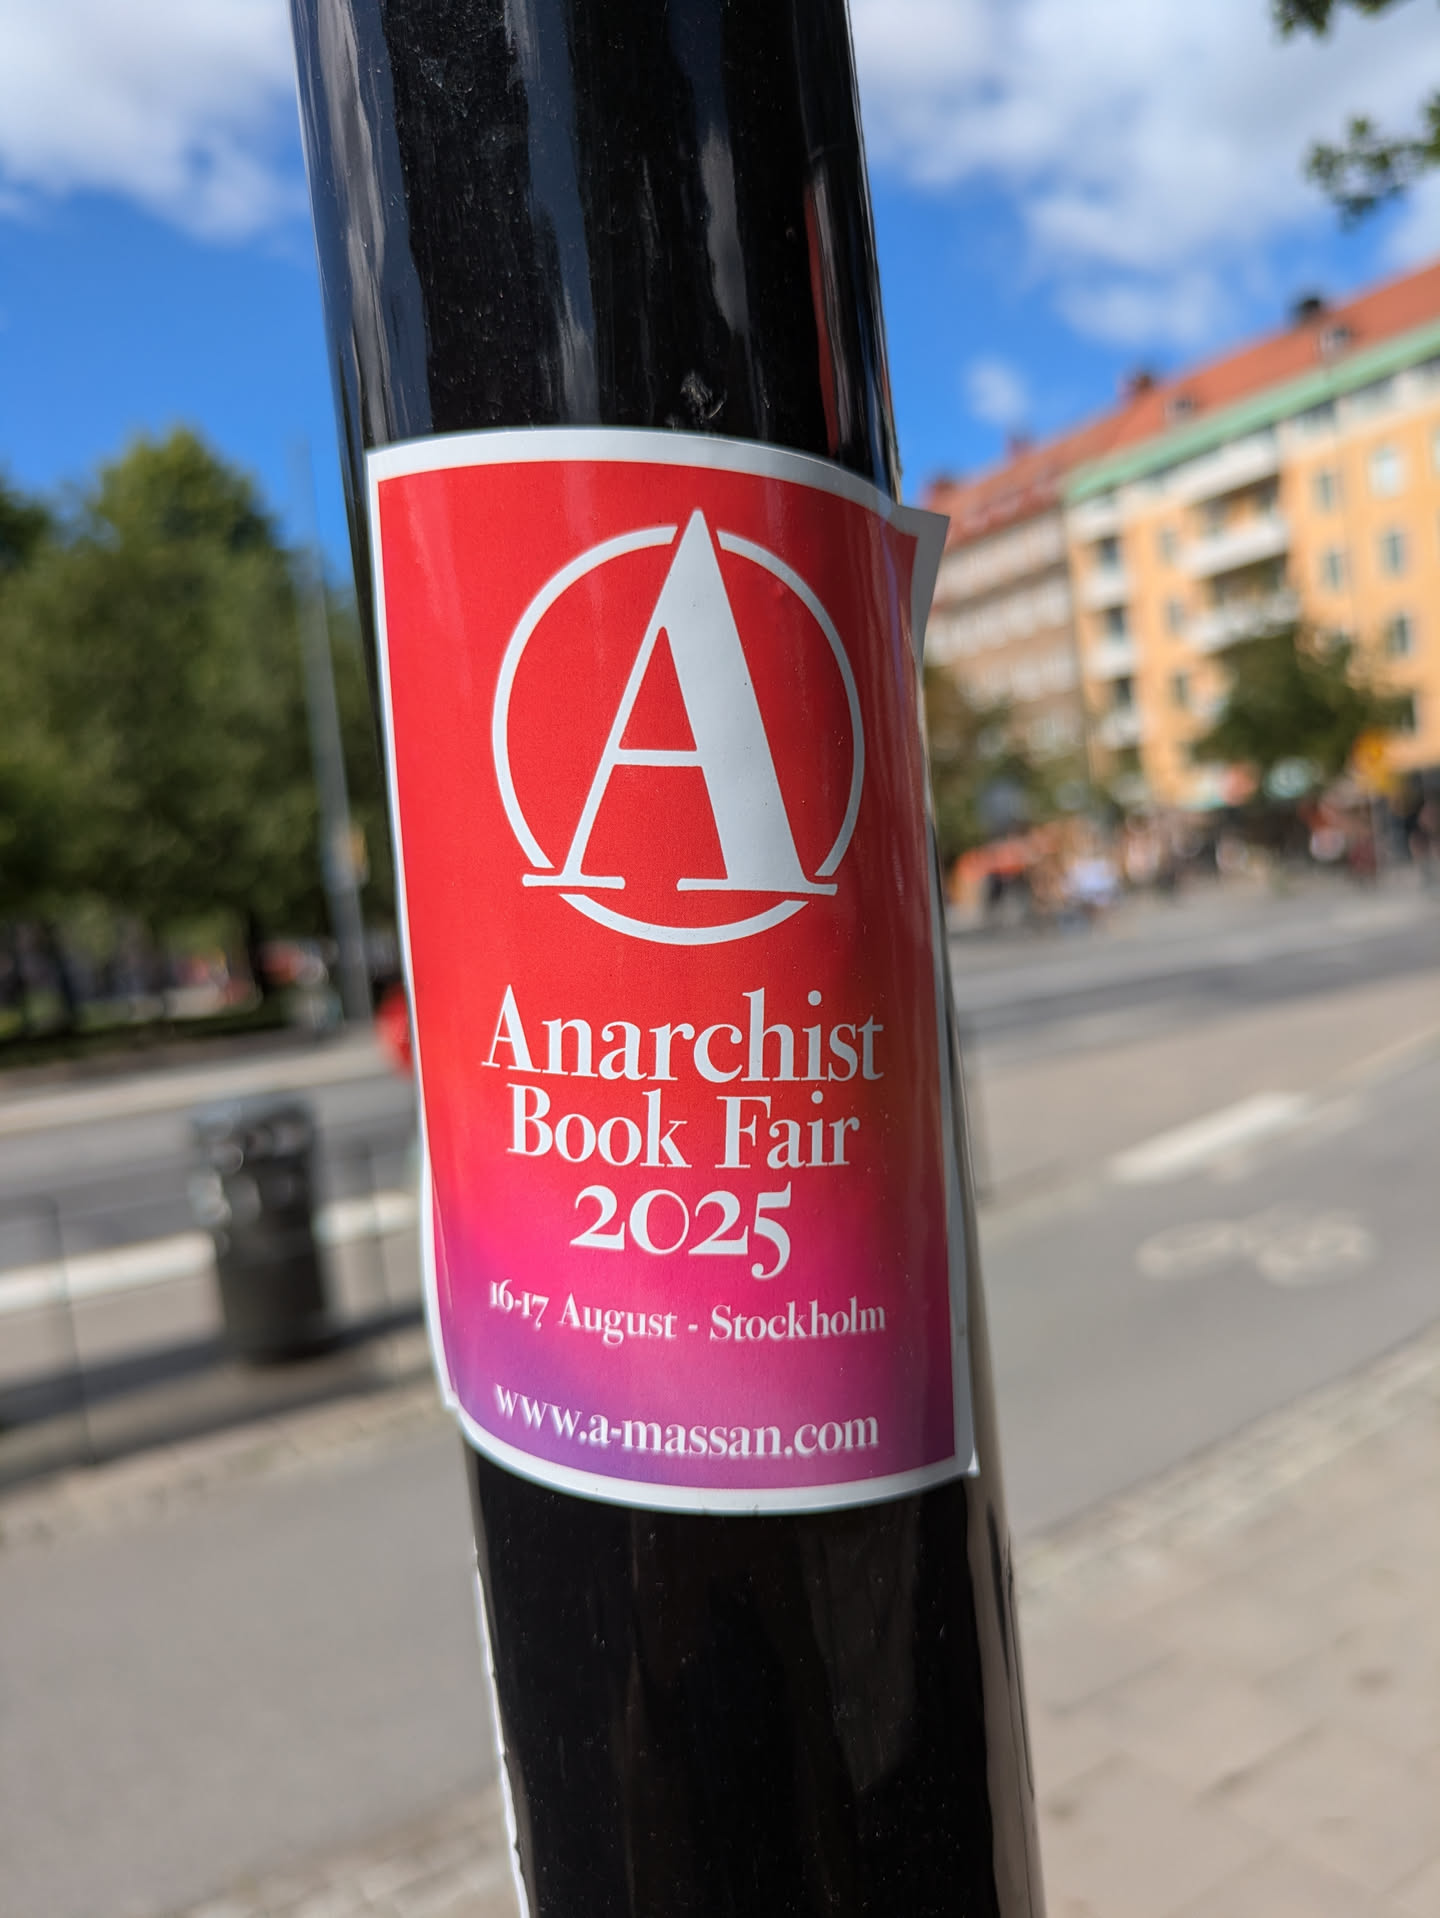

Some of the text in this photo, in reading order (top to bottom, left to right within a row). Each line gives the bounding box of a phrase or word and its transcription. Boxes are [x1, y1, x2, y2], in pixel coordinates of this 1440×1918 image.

[481, 983, 884, 1084] Anarchist
[506, 1082, 860, 1170] Book Fair
[569, 1180, 792, 1281] 2025
[488, 1279, 549, 1330] 16-17
[558, 1292, 678, 1346] August
[709, 1296, 886, 1342] Stockholm
[494, 1383, 880, 1460] www.a-massan.com
